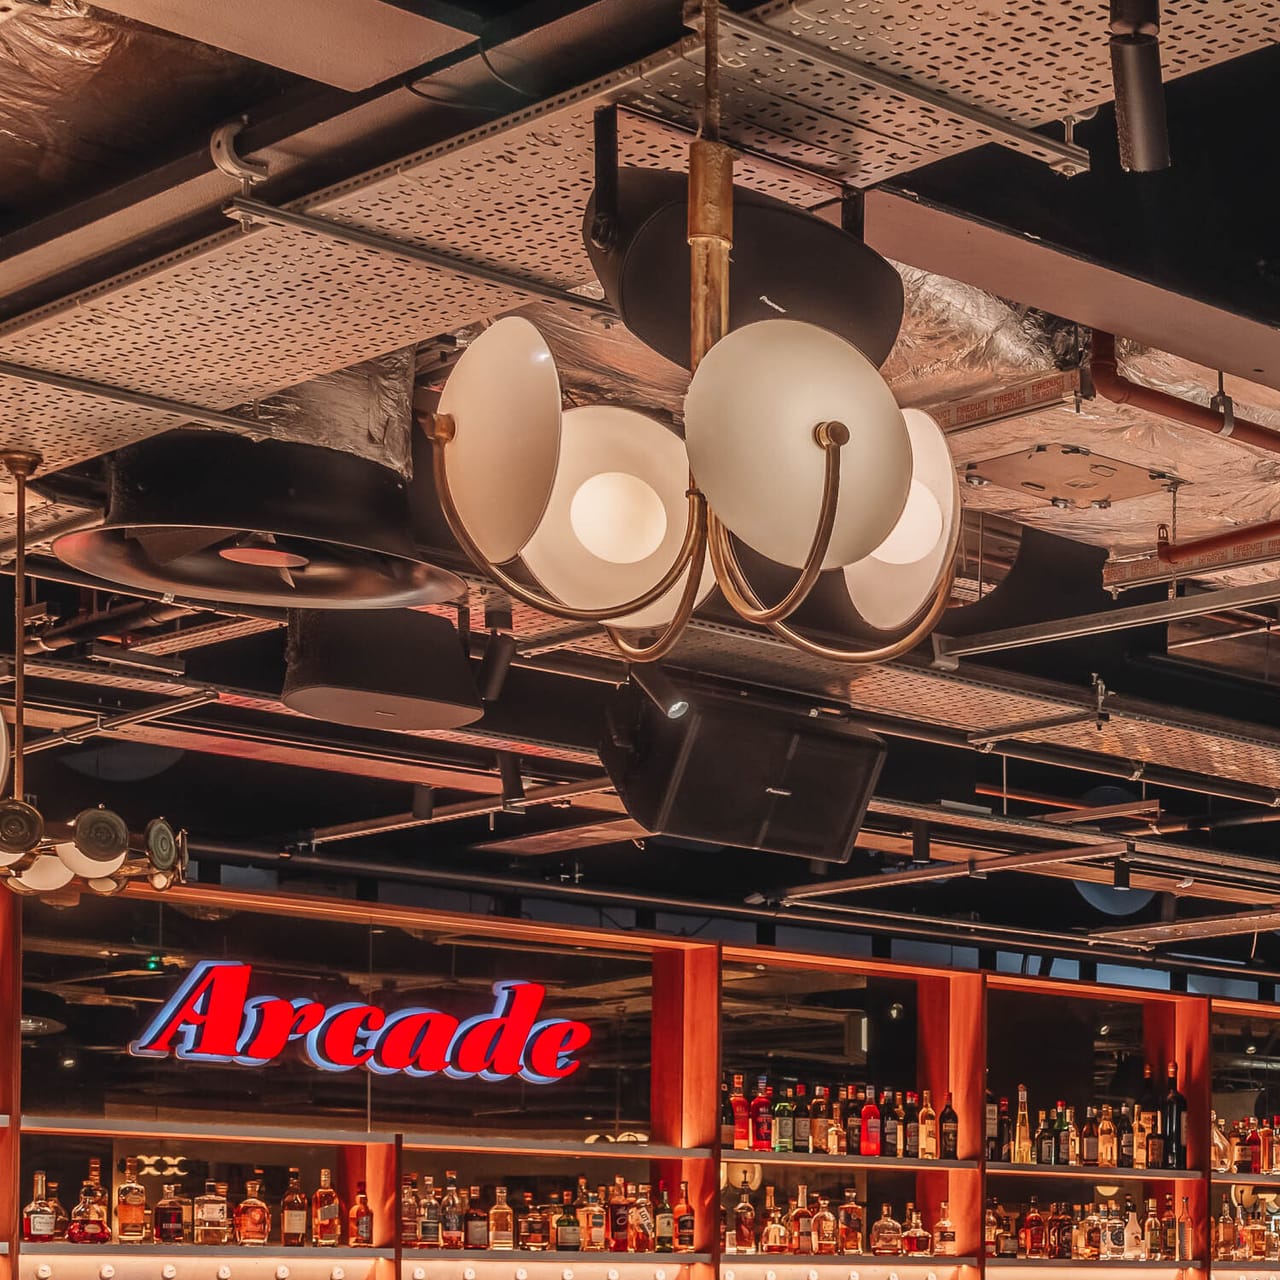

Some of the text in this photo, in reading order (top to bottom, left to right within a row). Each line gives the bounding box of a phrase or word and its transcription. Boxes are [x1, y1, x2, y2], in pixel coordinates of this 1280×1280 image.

[1032, 376, 1064, 393] FIREDUCT
[994, 389, 1026, 404] FIREDUCT
[956, 400, 987, 414] FIREDUCT
[129, 960, 592, 1084] Arcade
